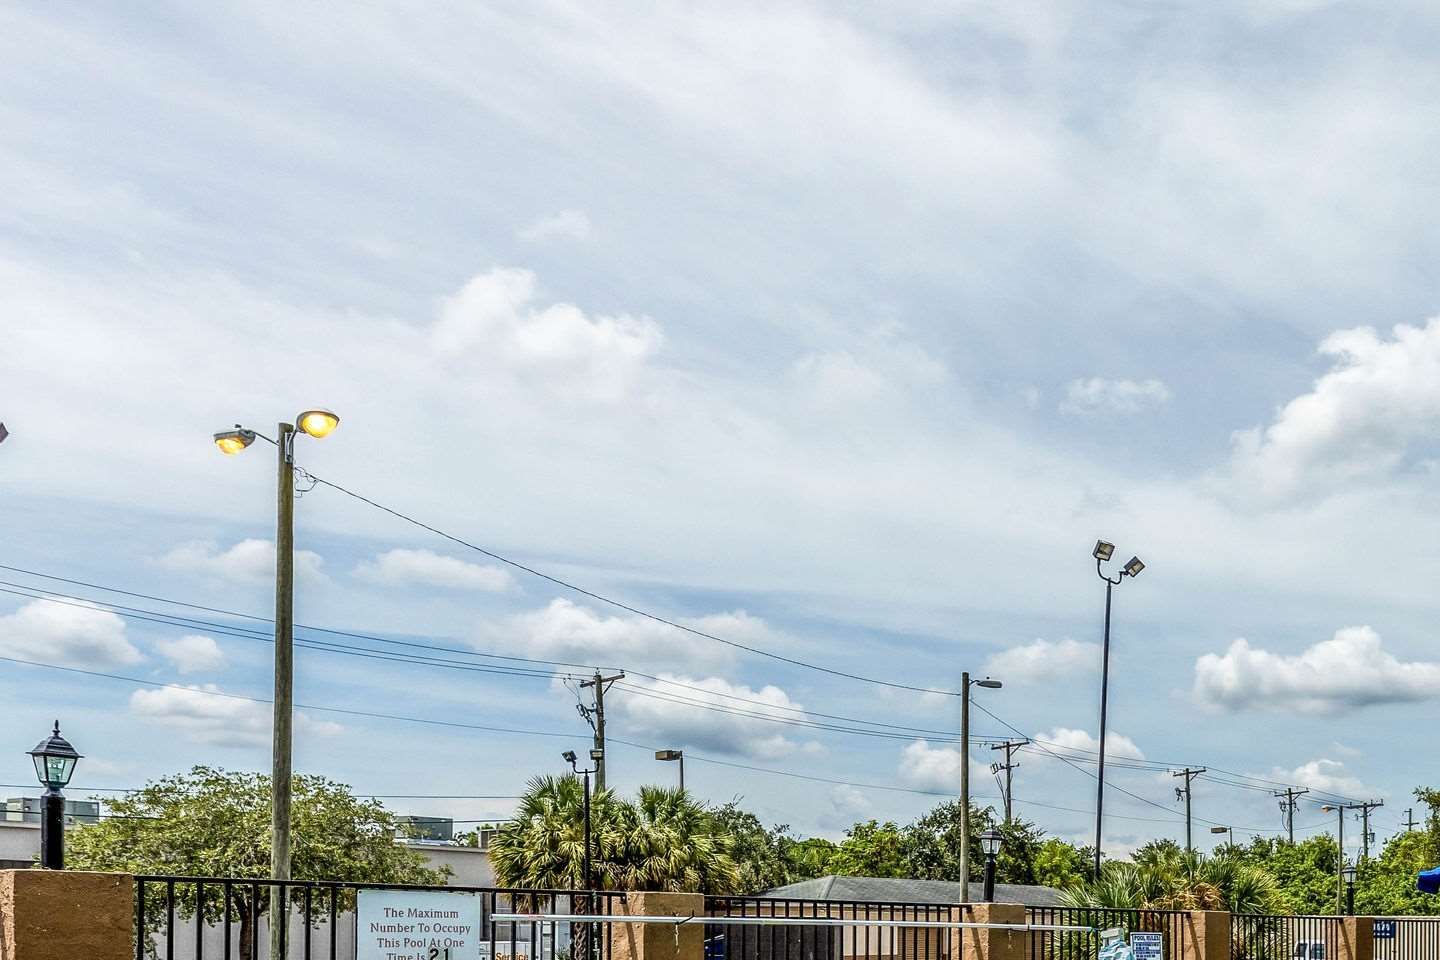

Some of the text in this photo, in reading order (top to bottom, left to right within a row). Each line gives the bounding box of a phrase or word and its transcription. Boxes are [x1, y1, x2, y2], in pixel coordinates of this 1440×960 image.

[383, 907, 459, 919] The Maximum
[370, 923, 471, 935] Number To Occupy
[377, 938, 465, 948] This Pool At One
